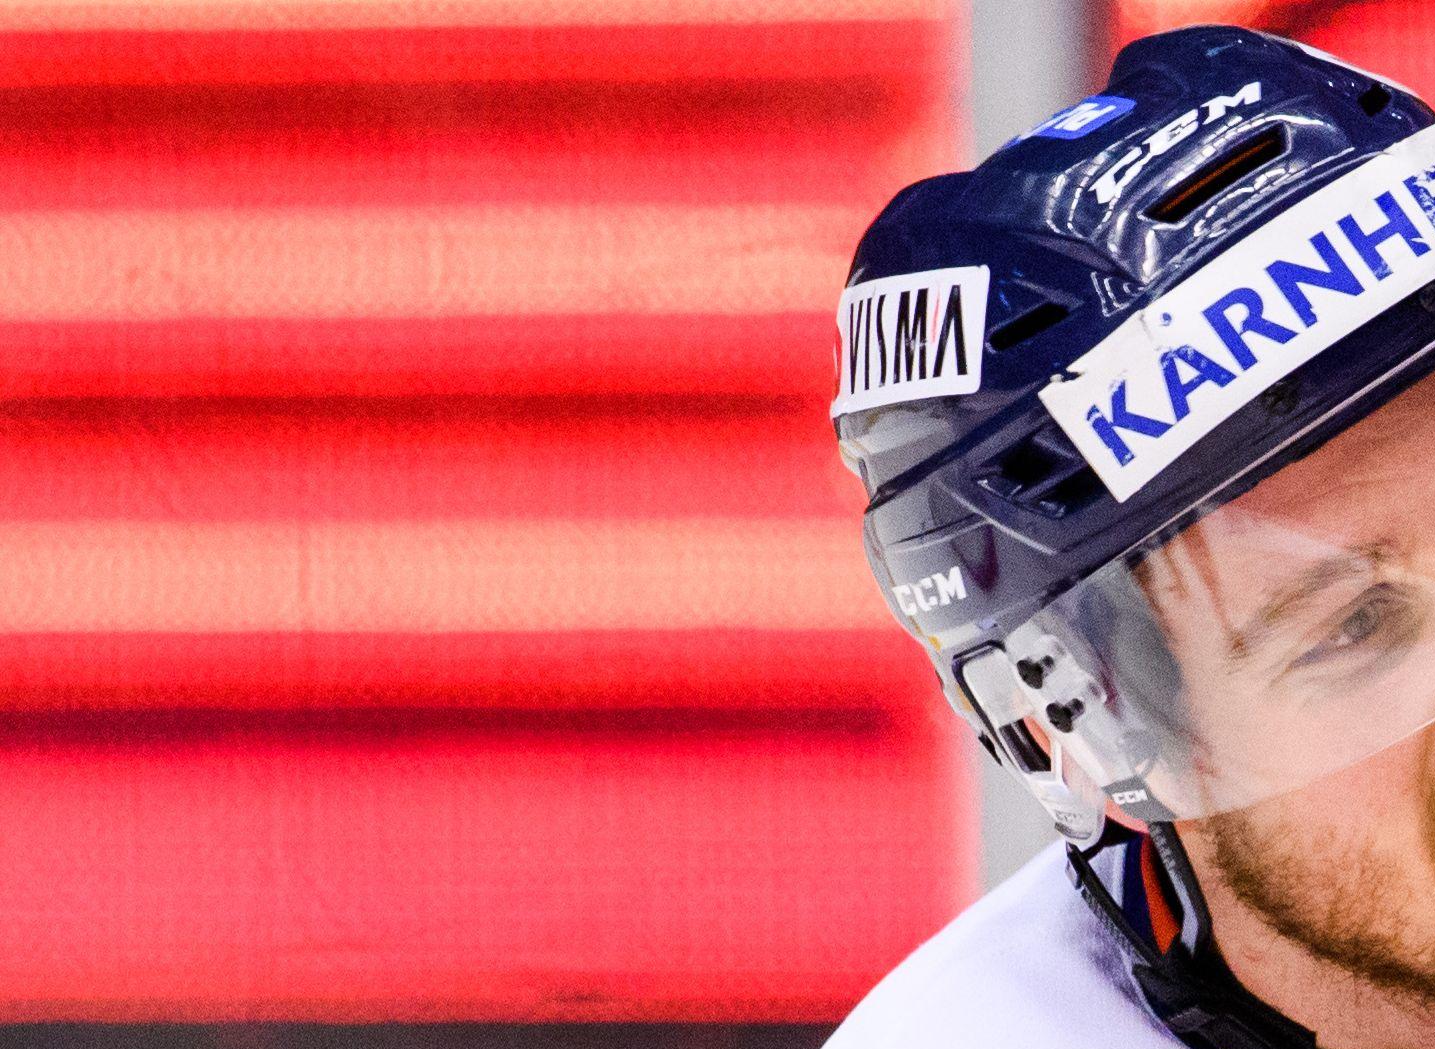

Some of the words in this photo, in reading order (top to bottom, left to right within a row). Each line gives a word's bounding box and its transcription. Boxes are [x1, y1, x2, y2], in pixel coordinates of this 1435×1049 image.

[1088, 81, 1261, 204] CCM
[850, 284, 968, 395] VISMA
[892, 565, 967, 616] CCM
